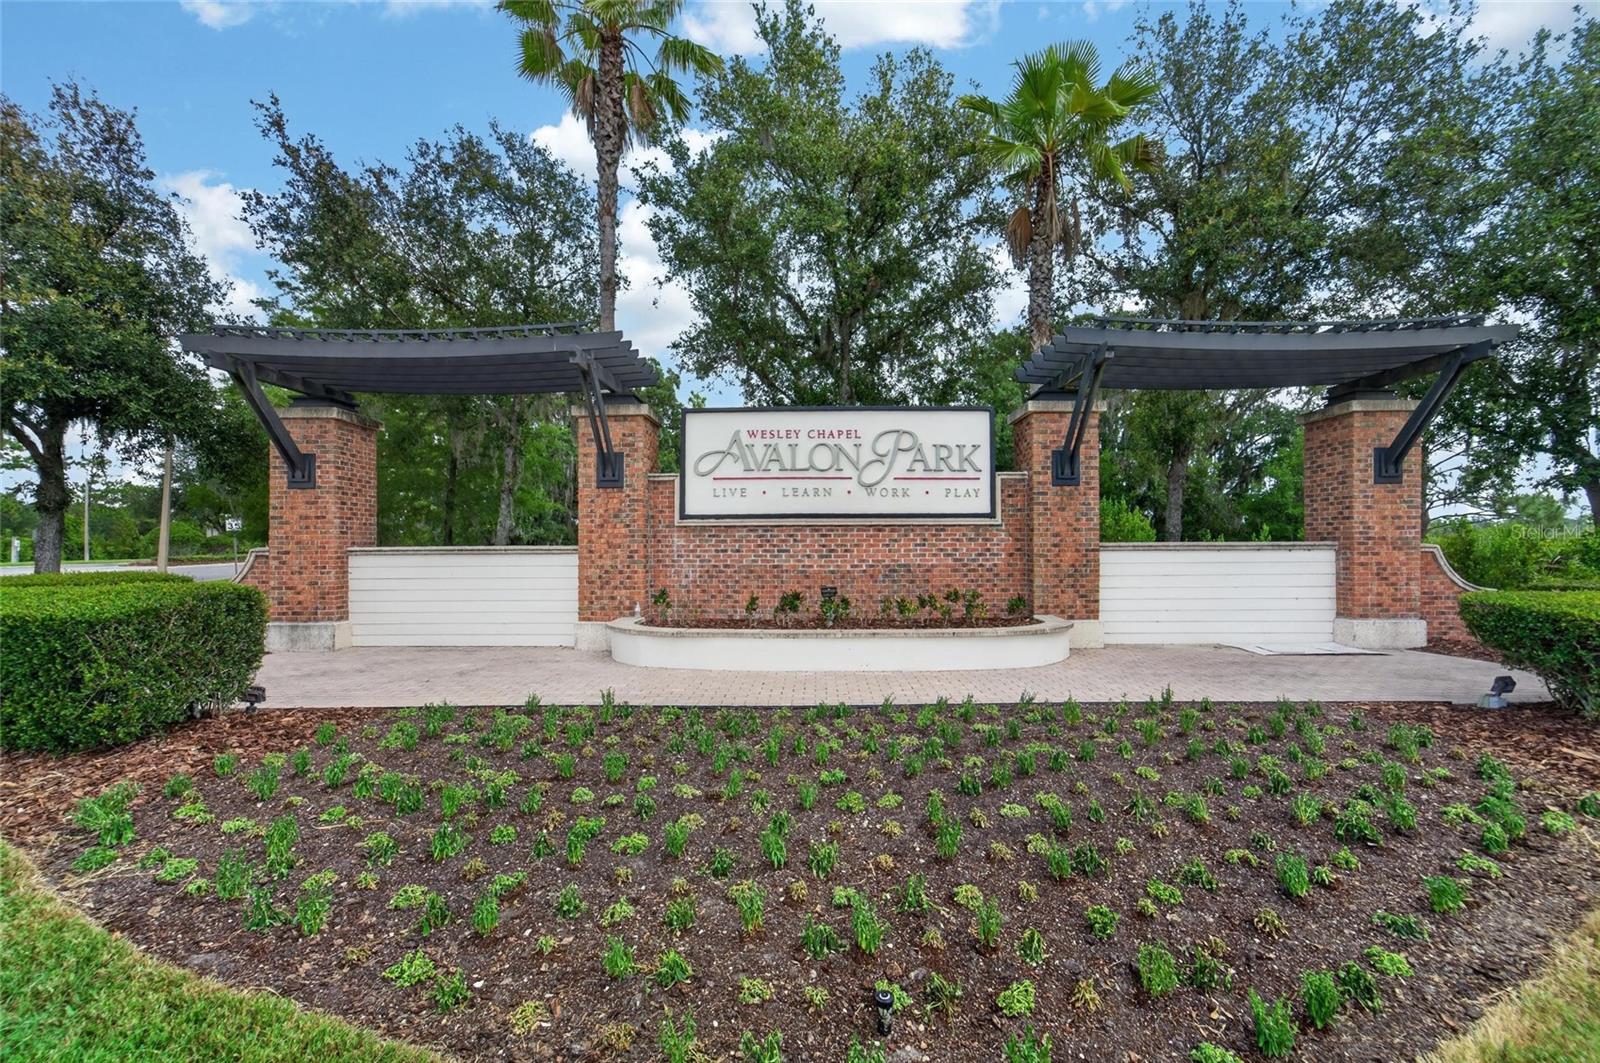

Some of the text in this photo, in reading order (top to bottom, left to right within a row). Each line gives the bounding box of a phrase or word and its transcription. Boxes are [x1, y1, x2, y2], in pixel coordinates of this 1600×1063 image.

[747, 429, 862, 439] WESLEY CHAPEL
[694, 429, 982, 487] AVALON PARK
[713, 487, 980, 498] LIVE LEARN WORK PLAY
